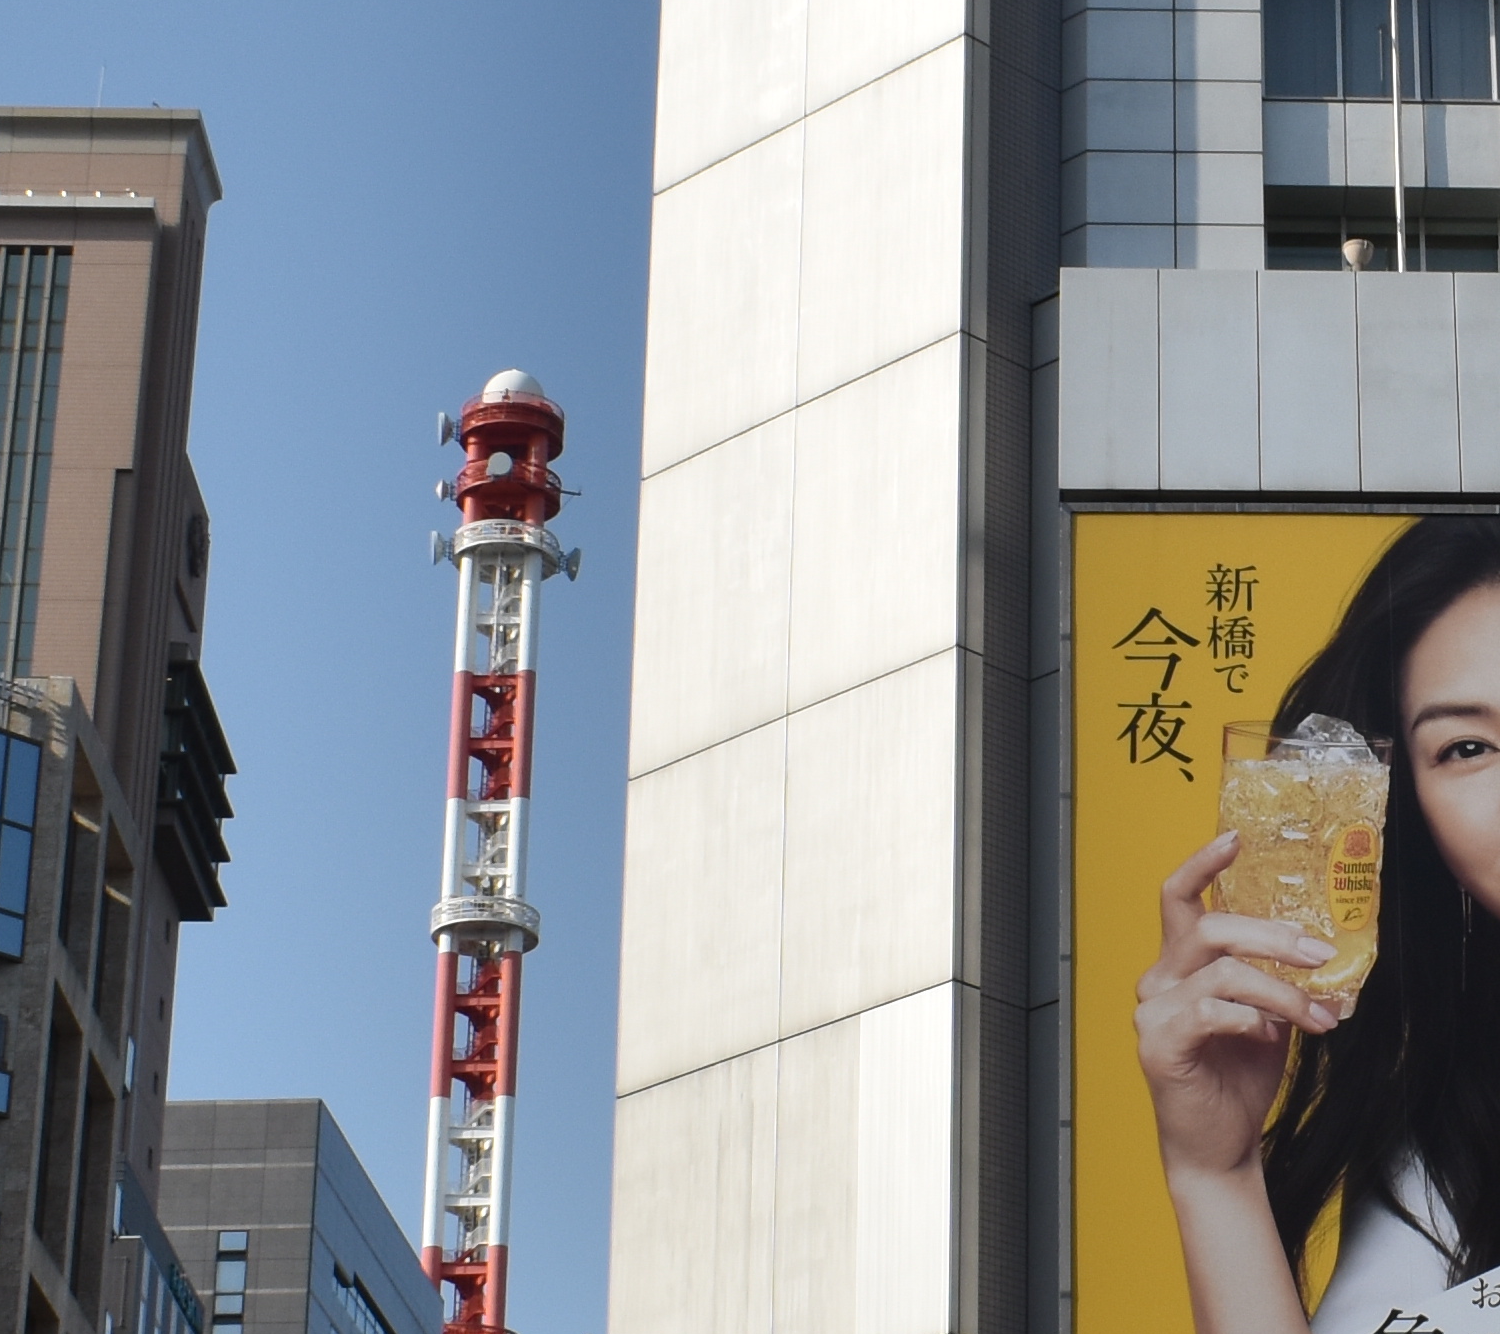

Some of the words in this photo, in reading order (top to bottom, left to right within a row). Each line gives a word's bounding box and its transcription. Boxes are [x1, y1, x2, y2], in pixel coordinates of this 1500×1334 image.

[1111, 607, 1202, 783] 今夜、
[1205, 563, 1260, 694] 新橋で
